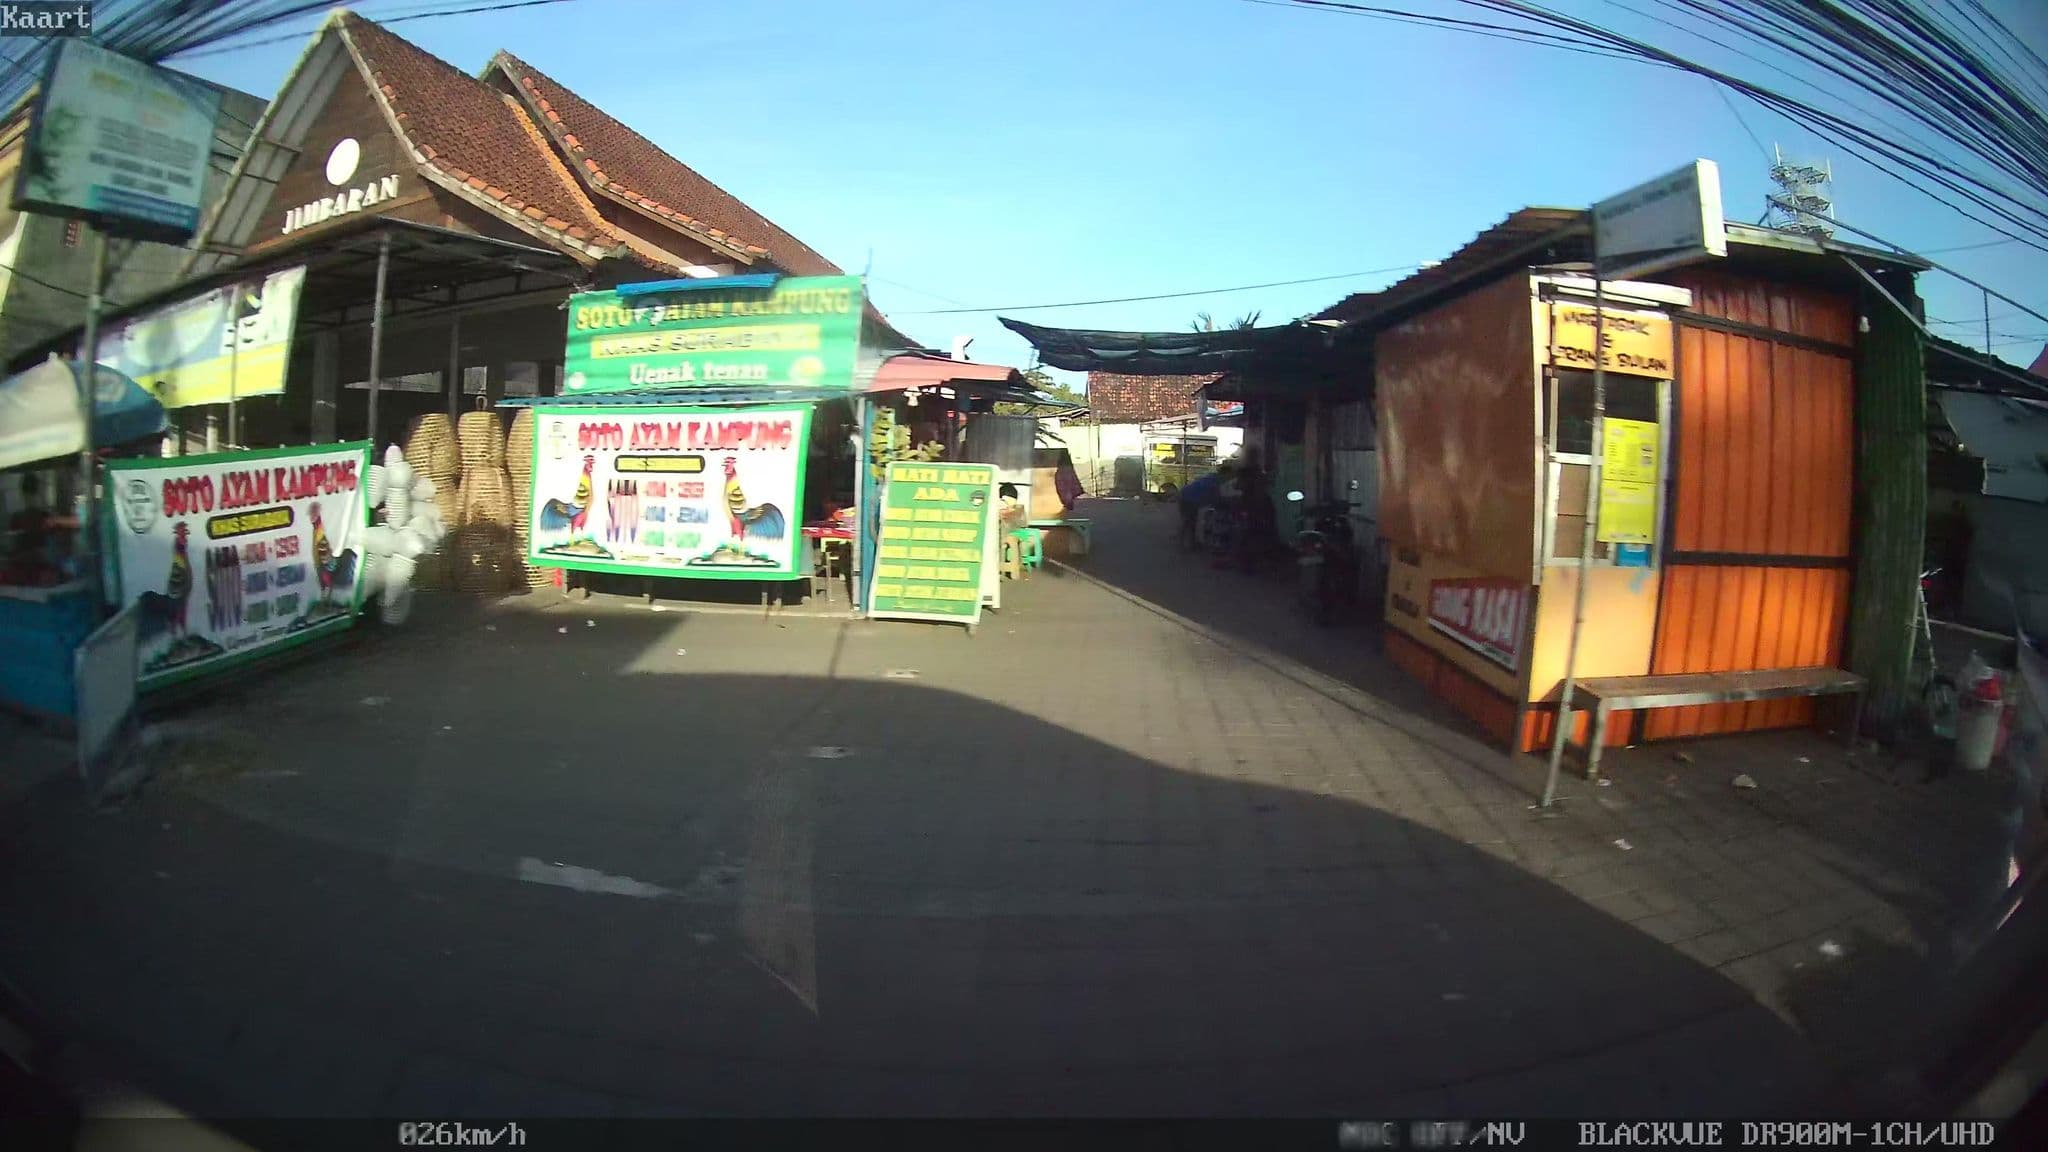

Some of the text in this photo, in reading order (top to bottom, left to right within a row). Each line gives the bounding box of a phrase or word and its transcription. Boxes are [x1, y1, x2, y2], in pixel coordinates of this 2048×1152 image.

[281, 174, 400, 235] JIMBARAN
[576, 305, 632, 330] SOTO
[577, 421, 624, 451] SOTO
[629, 421, 682, 451] AYAM
[686, 420, 793, 451] KAMPUNG
[162, 474, 215, 518] SOTO
[219, 468, 271, 510] AYAM
[274, 459, 358, 502] KAMPUNG
